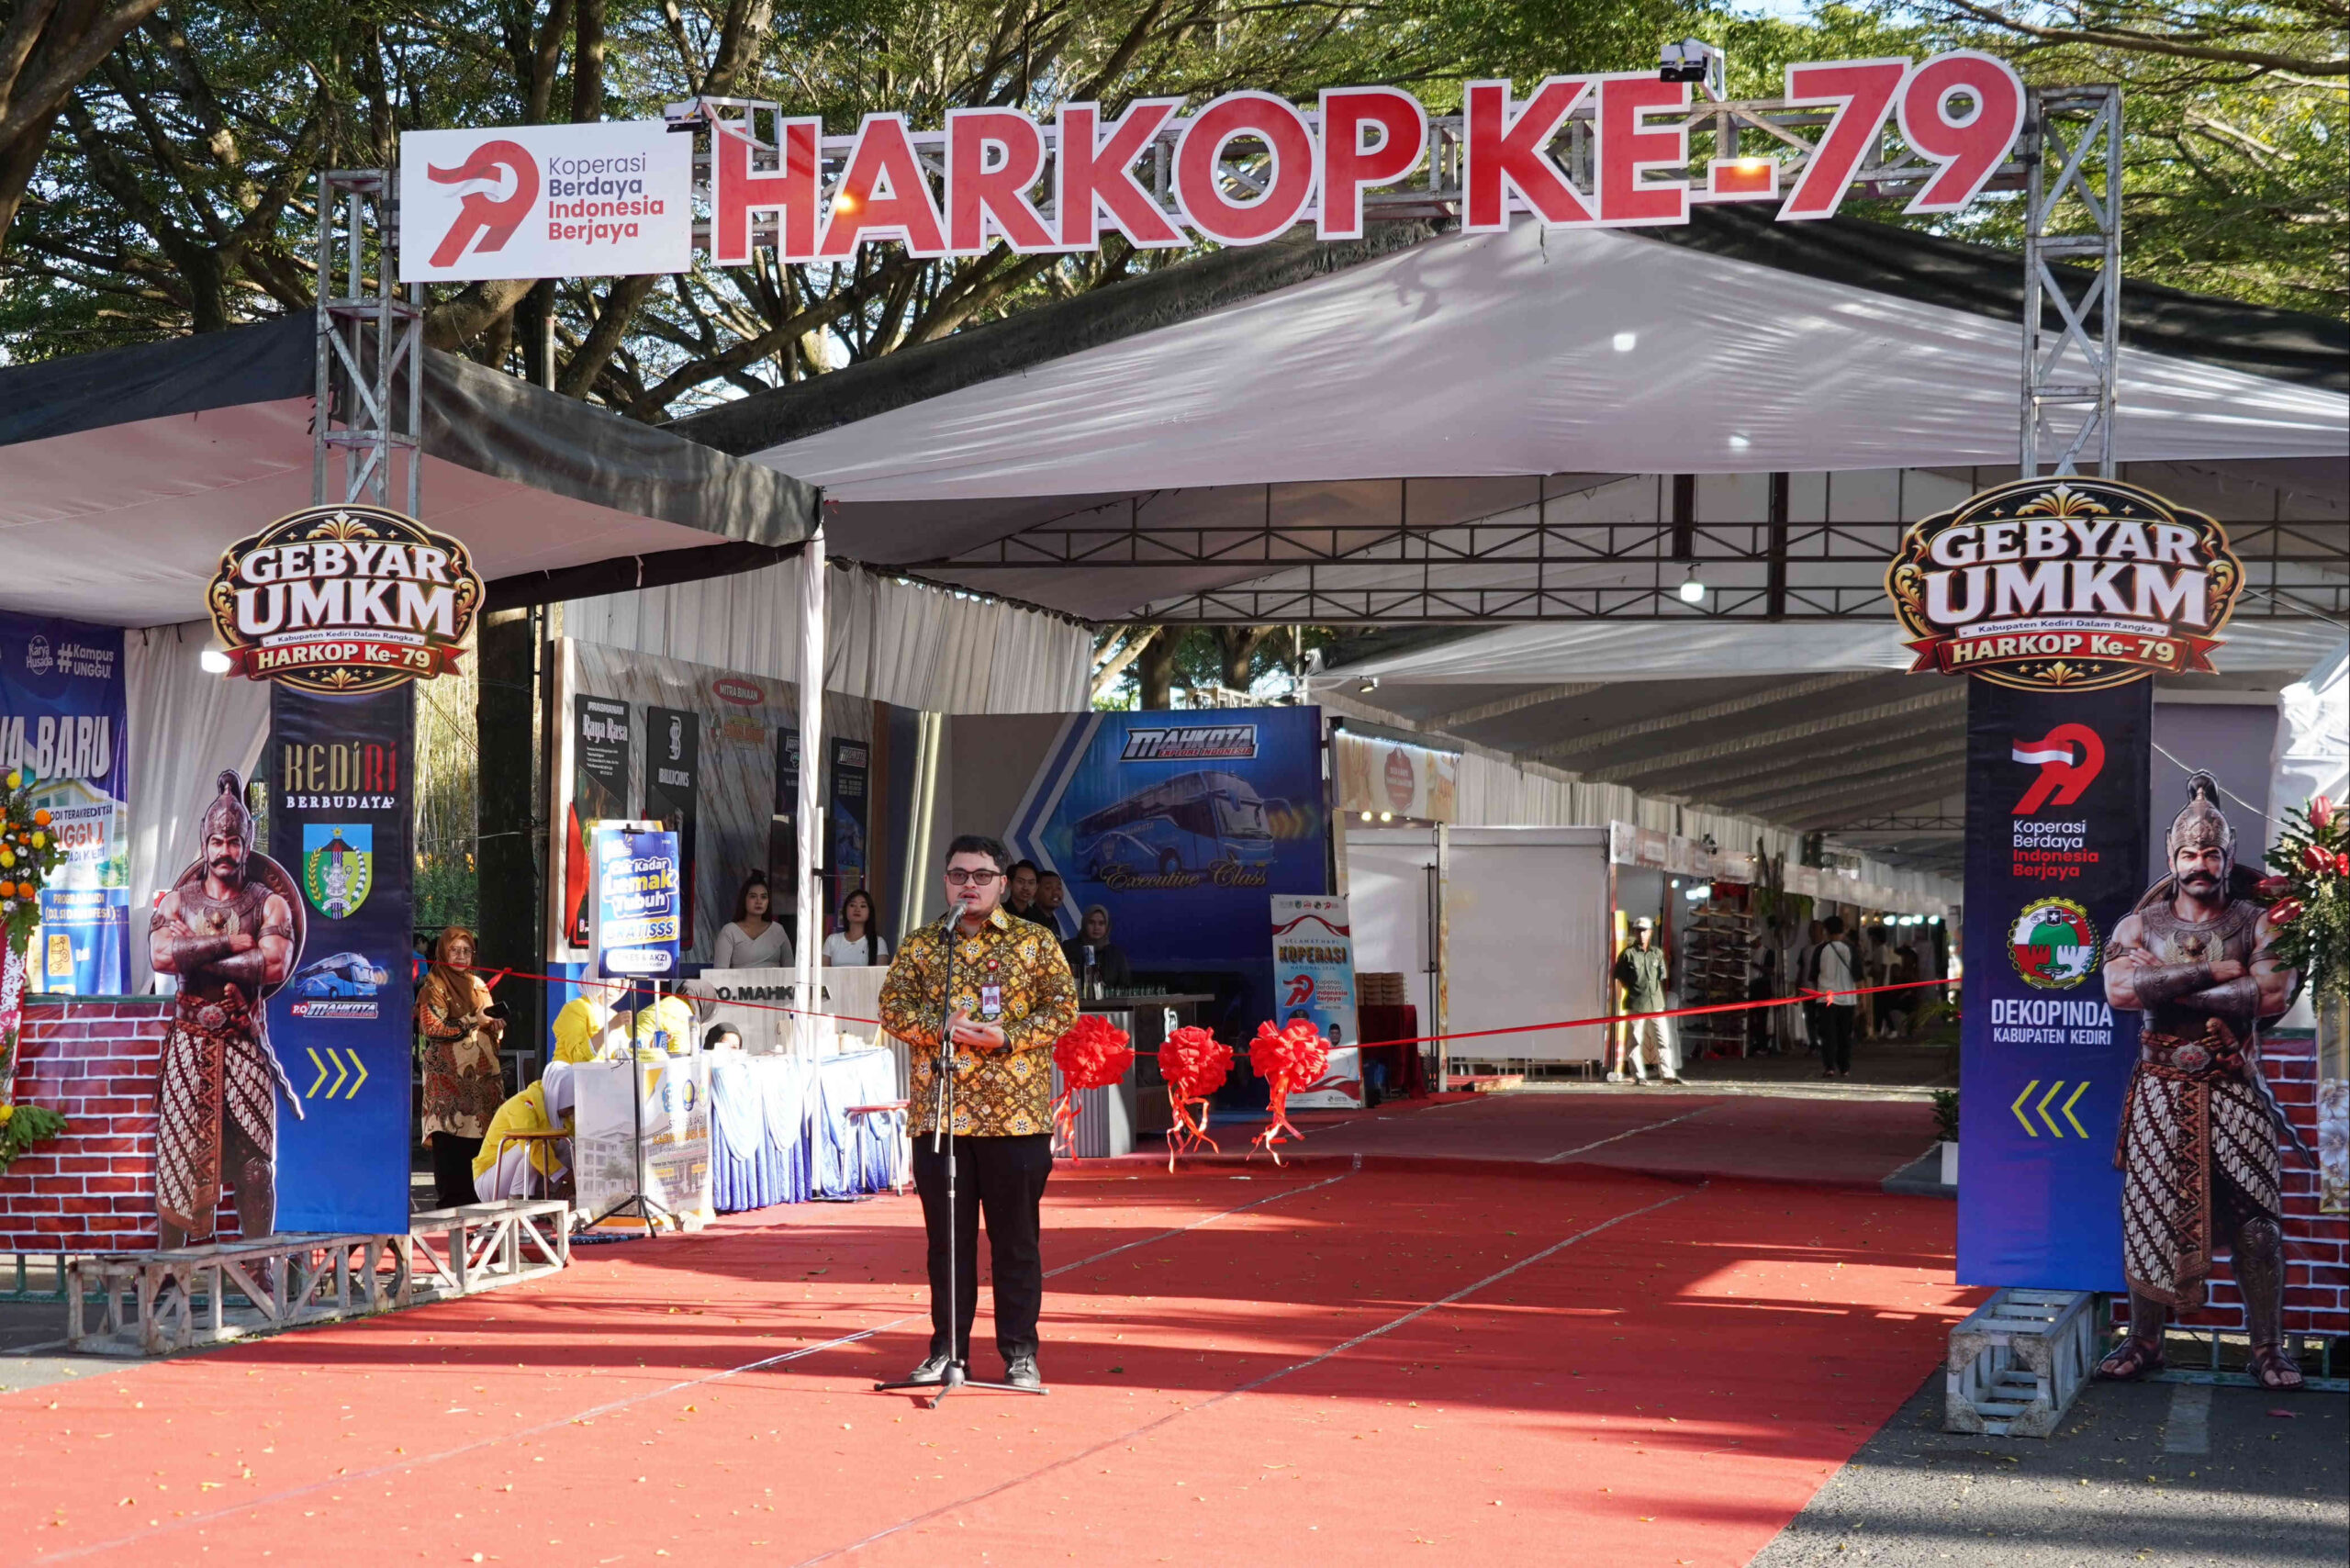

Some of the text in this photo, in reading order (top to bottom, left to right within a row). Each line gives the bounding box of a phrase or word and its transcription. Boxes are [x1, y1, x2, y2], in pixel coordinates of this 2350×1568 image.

[549, 152, 646, 180] Koperasi
[711, 50, 2026, 266] HARKOP KE-79
[549, 176, 643, 200] Berdaya
[548, 195, 664, 218] Indonesia
[548, 220, 639, 245] Berjaya
[1930, 517, 2201, 567] GEBYAR
[239, 542, 448, 585] GEBYAR
[1924, 561, 2210, 628] UMKM
[235, 578, 458, 636] UMKM
[1977, 619, 2154, 633] Kabupaten Kediri Dalam Rangka
[277, 632, 324, 643] Kabupaten
[353, 631, 381, 639] Dalam
[383, 632, 414, 643] Rangka
[28, 644, 50, 657] Karya
[257, 643, 359, 670] HARKOP
[1952, 633, 2084, 664] HARKOP
[26, 655, 53, 669] Husada
[719, 684, 758, 701] MITRA BINAAN
[588, 701, 624, 715] PRASMANAN
[582, 714, 628, 744] Raya Rasa
[36, 715, 110, 779] BARU
[1130, 728, 1252, 757] MAHKOTA
[1158, 746, 1253, 756] EXPLORE INDONESIA
[658, 767, 689, 788] BILLIONS
[286, 796, 396, 810] BERBUDAYA
[2013, 820, 2087, 836] Koperasi
[2013, 834, 2084, 852] Berdaya
[634, 859, 666, 872] Kadar
[2013, 848, 2099, 863] Indonesia
[1101, 859, 1266, 890] Executive Class
[2013, 863, 2080, 881] Berjaya
[1279, 946, 1347, 963] KOPERASI
[308, 1003, 376, 1016] MAHKOTA
[1991, 999, 2114, 1027] DEKOPINDA
[1993, 1027, 2111, 1046] KABUPATEN KEDIRI
